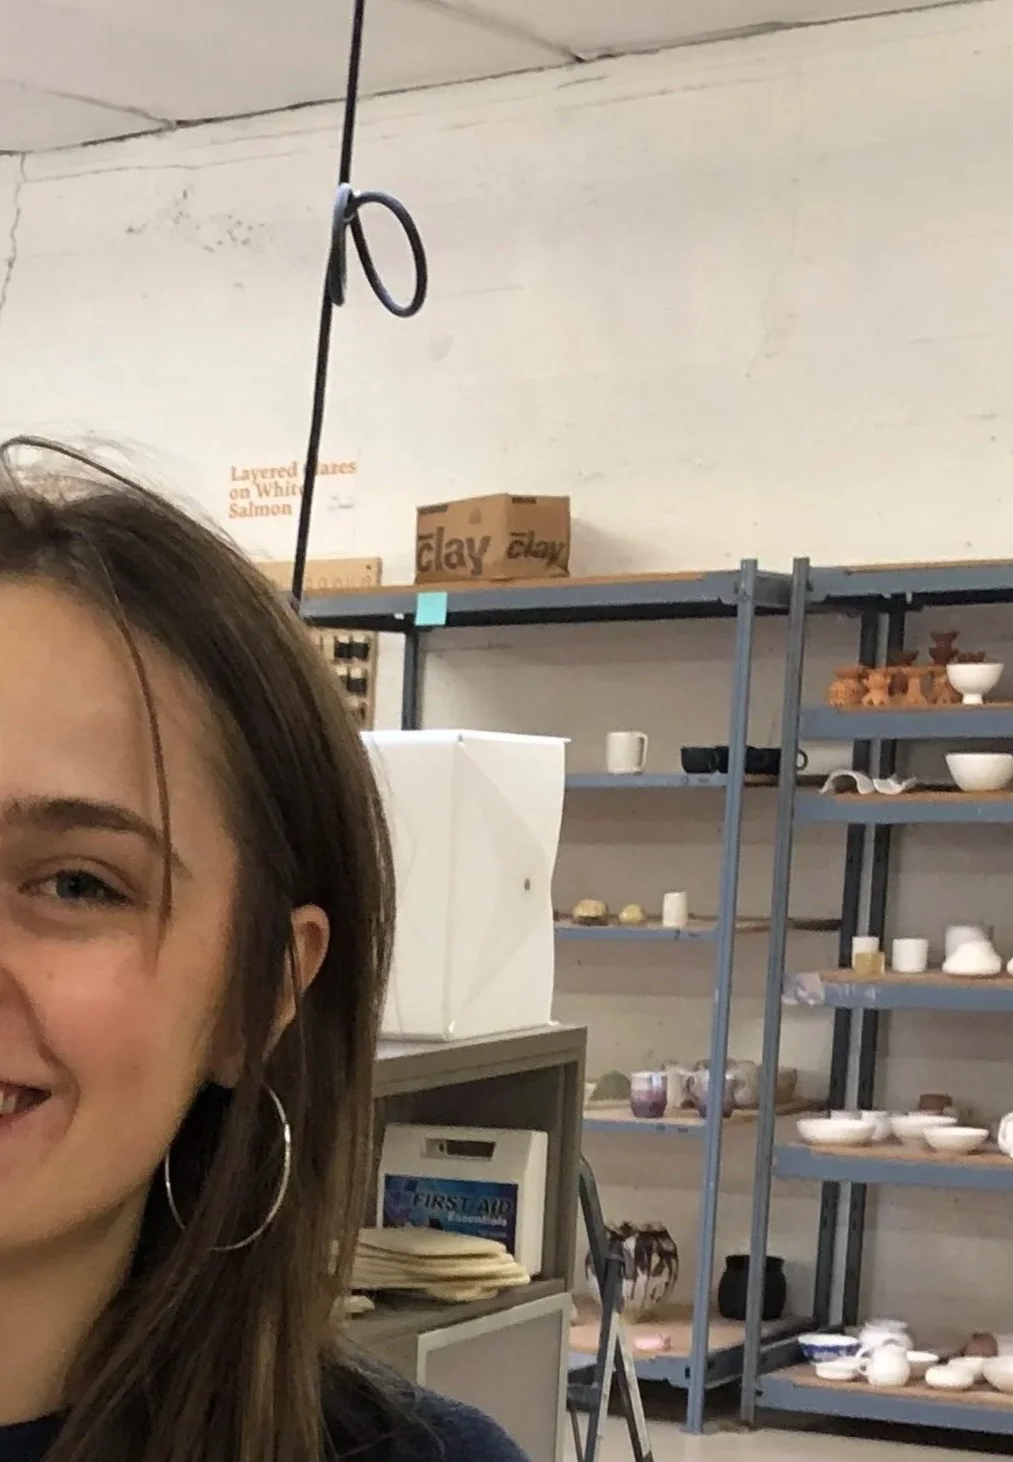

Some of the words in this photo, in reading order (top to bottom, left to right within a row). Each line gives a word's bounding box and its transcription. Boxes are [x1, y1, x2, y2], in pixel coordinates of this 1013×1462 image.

[230, 460, 298, 483] Layered
[229, 488, 250, 500] on
[229, 501, 293, 519] Salmon
[418, 526, 491, 576] clay
[507, 530, 565, 567] clay
[413, 1191, 473, 1213] FIRST
[477, 1196, 511, 1217] AID
